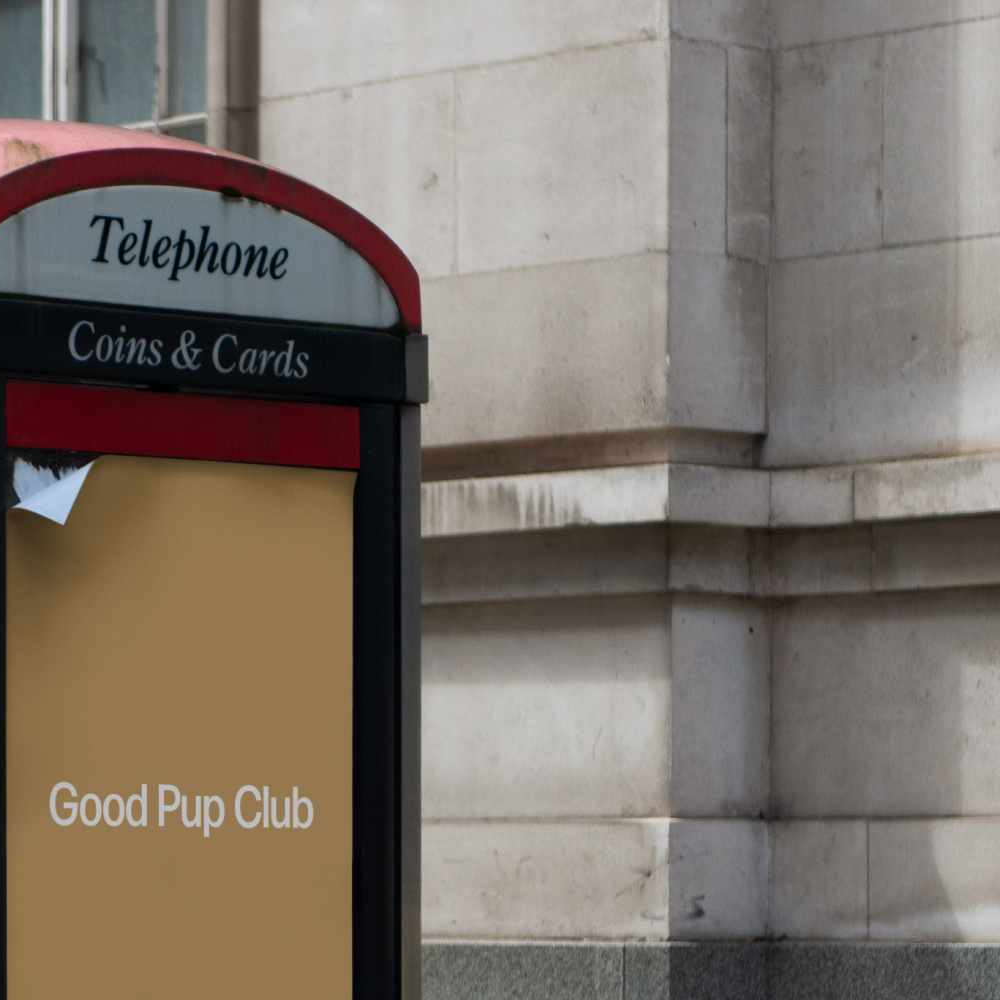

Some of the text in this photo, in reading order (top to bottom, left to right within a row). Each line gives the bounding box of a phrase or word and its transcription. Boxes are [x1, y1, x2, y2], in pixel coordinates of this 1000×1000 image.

[89, 214, 289, 281] Telephone
[68, 320, 309, 378] Coins & Cards
[49, 781, 314, 838] Good Pup Club
